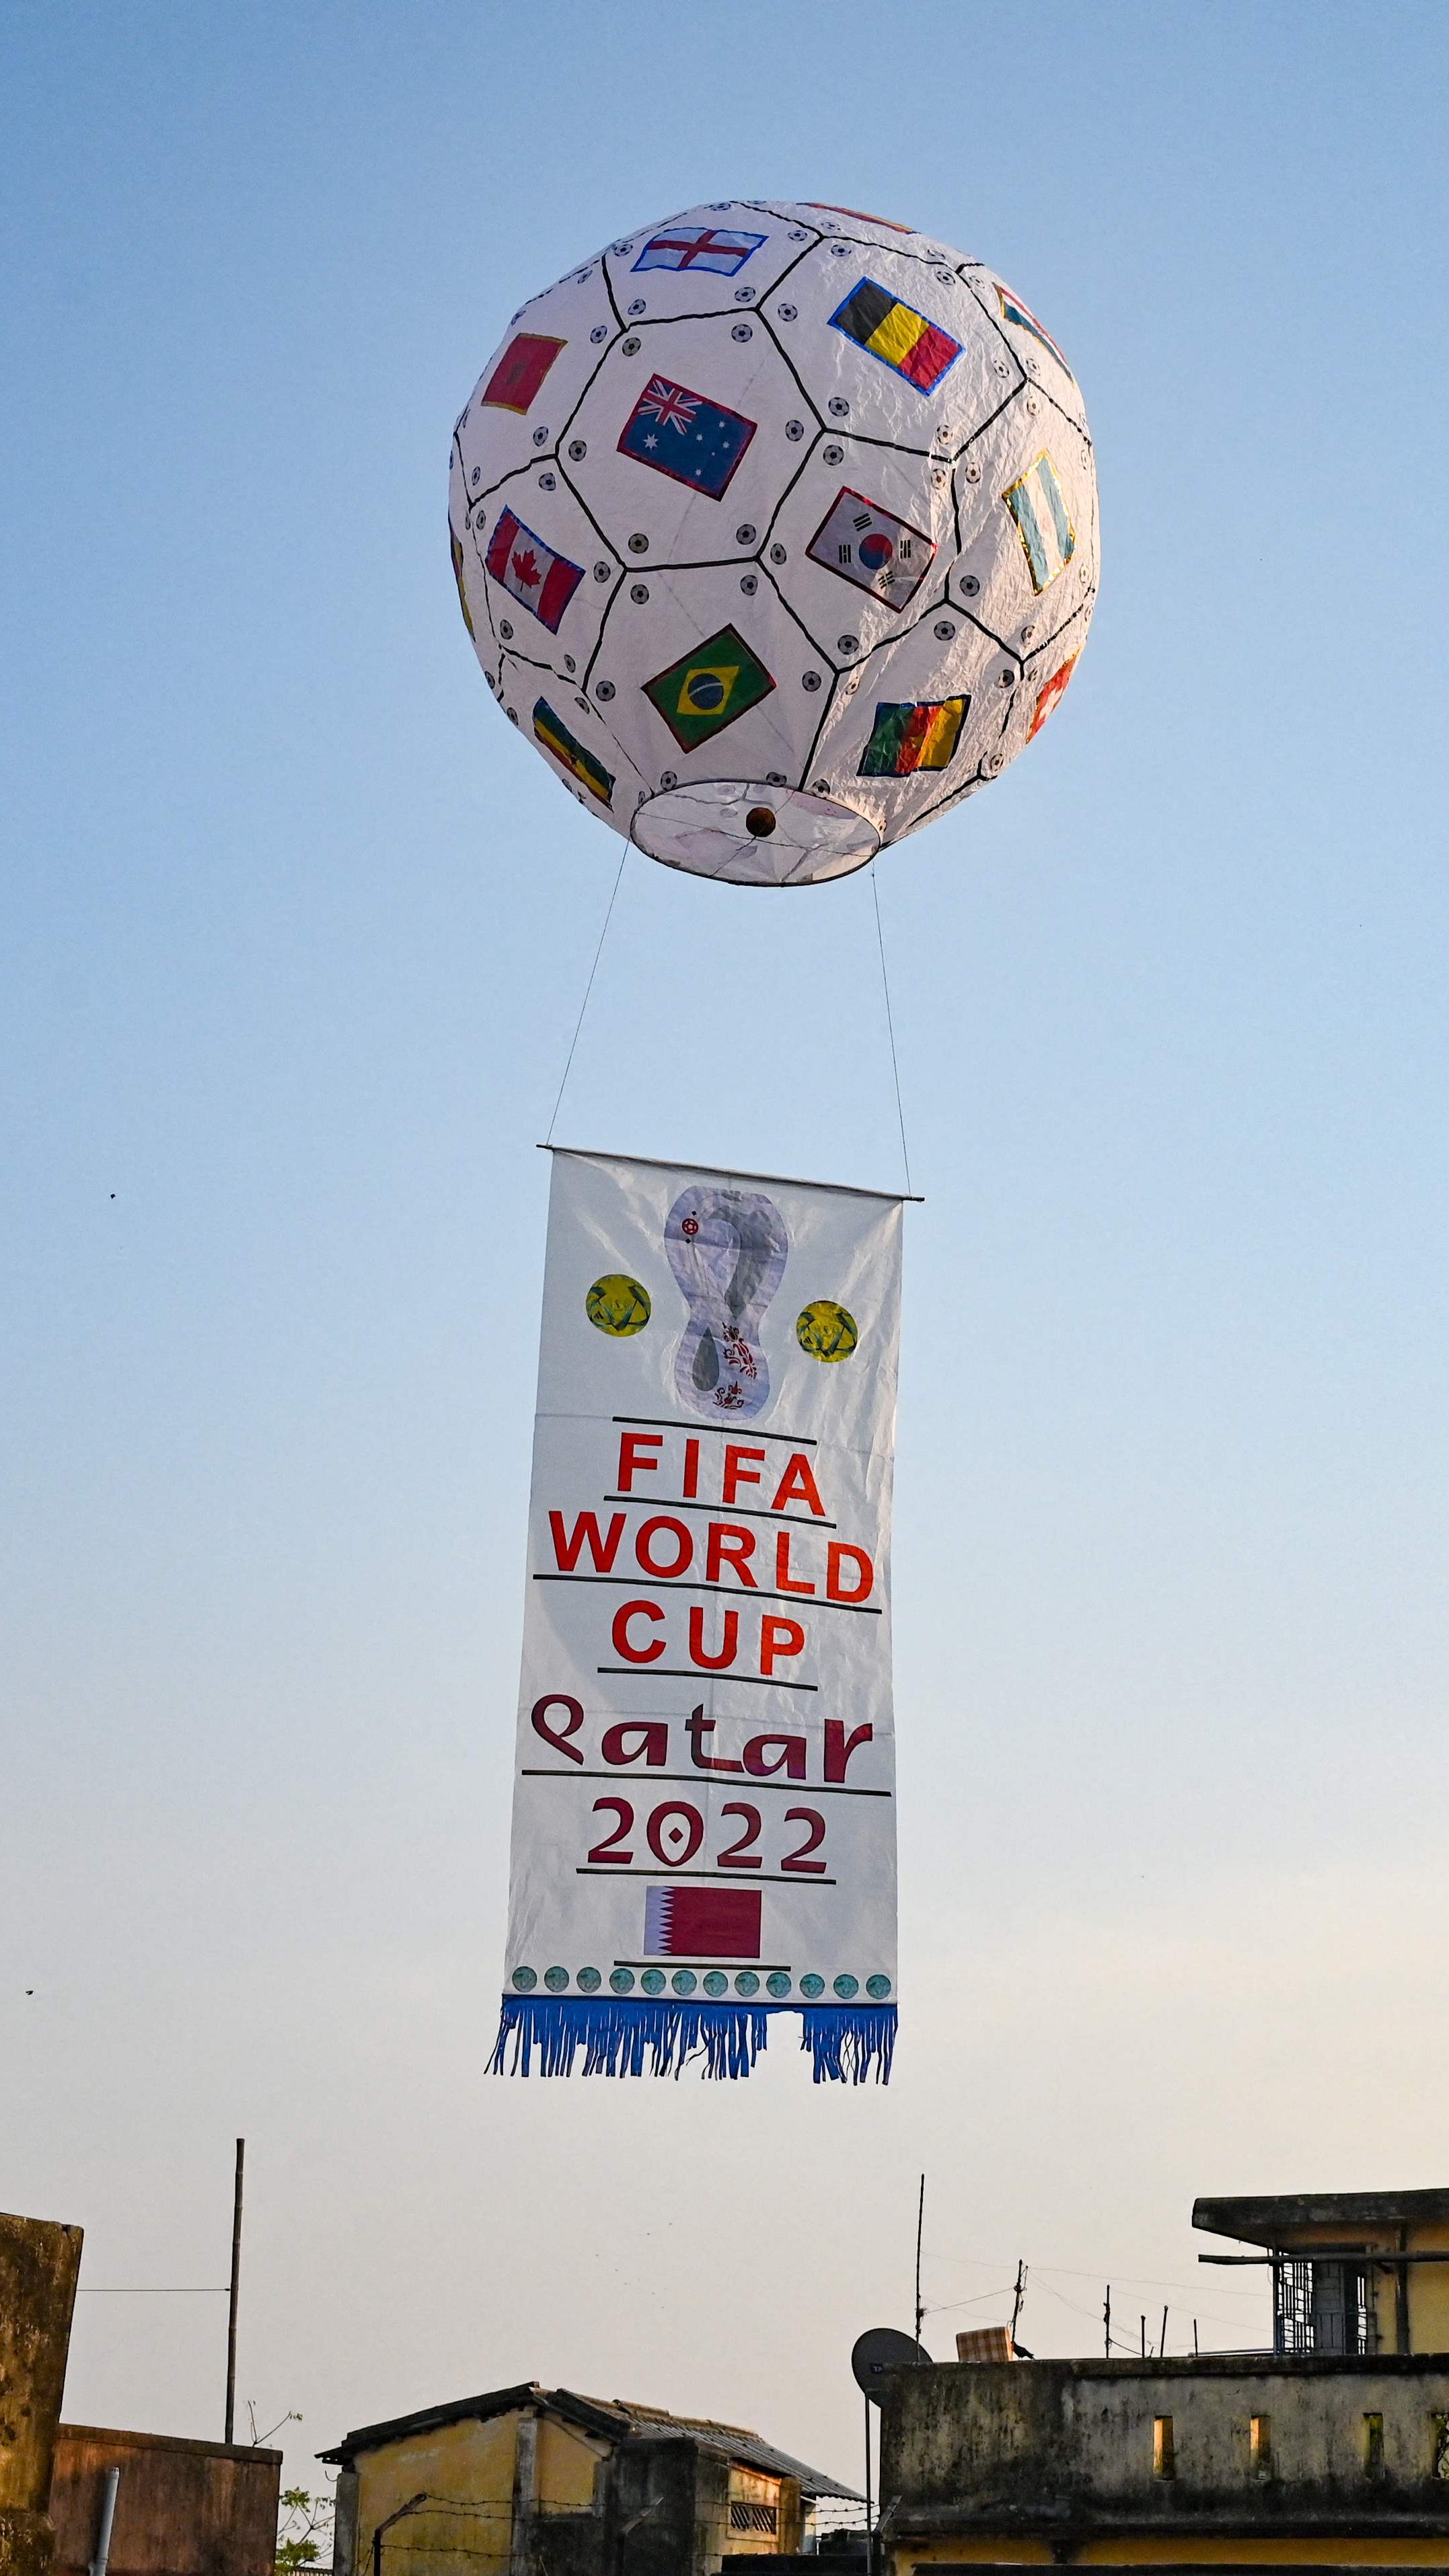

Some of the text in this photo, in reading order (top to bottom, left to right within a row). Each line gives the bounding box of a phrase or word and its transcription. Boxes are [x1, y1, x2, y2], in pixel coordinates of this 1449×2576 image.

[618, 1432, 826, 1517] FIFA
[549, 1511, 875, 1603] WORLD
[611, 1600, 805, 1676] CUP
[531, 1694, 872, 1783] Qatar
[587, 1797, 827, 1873] 2022
